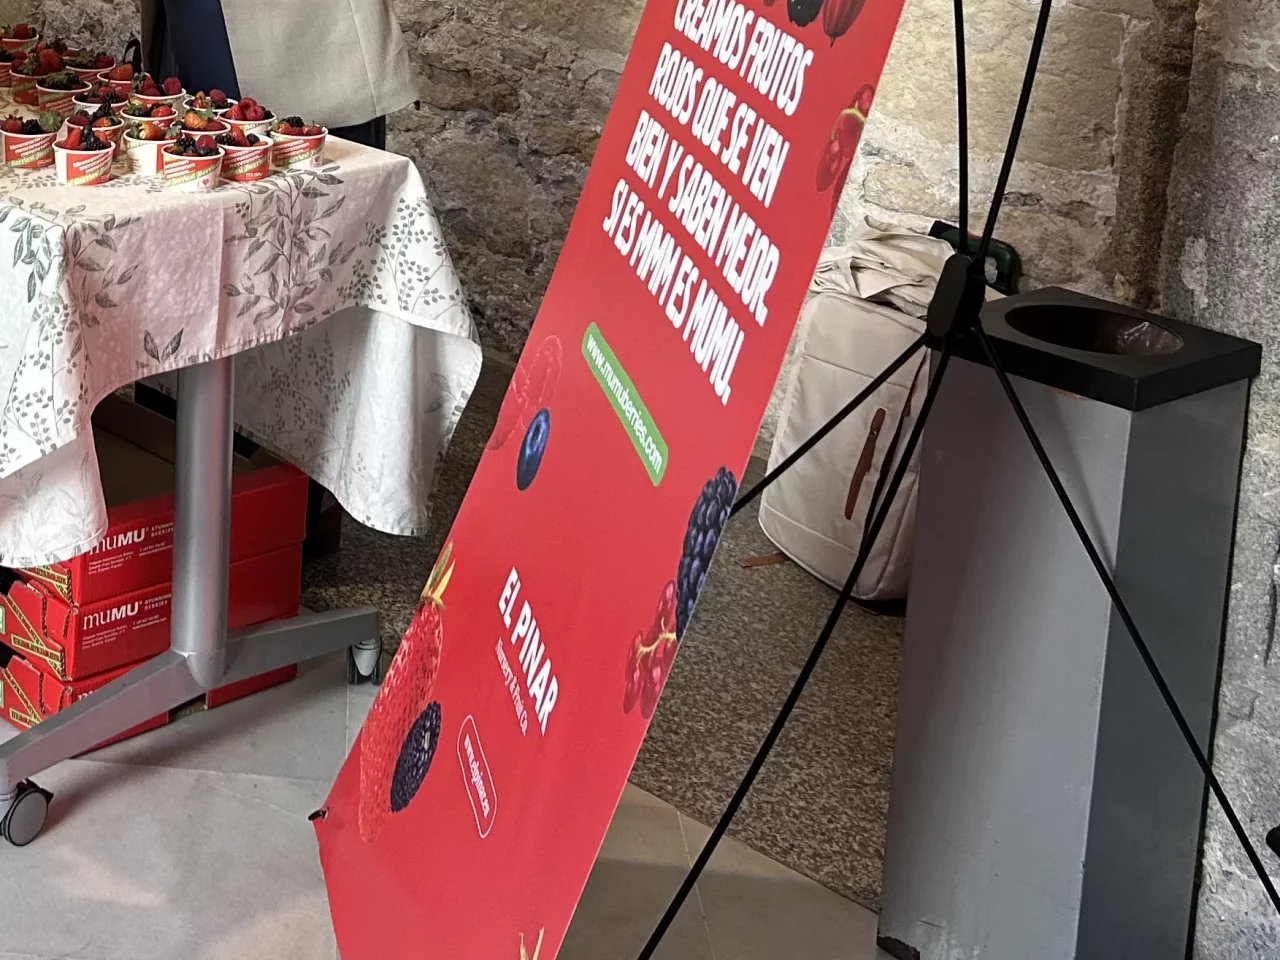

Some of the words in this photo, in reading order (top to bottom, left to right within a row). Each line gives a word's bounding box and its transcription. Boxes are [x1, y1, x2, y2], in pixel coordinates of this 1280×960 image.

[739, 16, 814, 117] FRUTOS
[625, 109, 670, 189] BIEN
[648, 41, 704, 125] ROJOS
[691, 77, 737, 156] QUE
[720, 102, 757, 175] SE
[741, 117, 790, 209] VEN
[657, 139, 684, 200] Y
[602, 178, 629, 238] SI
[613, 191, 645, 256] ES
[667, 154, 733, 258] SABEN
[629, 210, 682, 306] MMM
[665, 255, 700, 329] ES
[714, 202, 780, 327] MEJOR.
[682, 278, 745, 406] MUMU.
[586, 333, 663, 475] www.mumuberries.com
[498, 566, 521, 629] EL
[510, 600, 559, 737] PINAR
